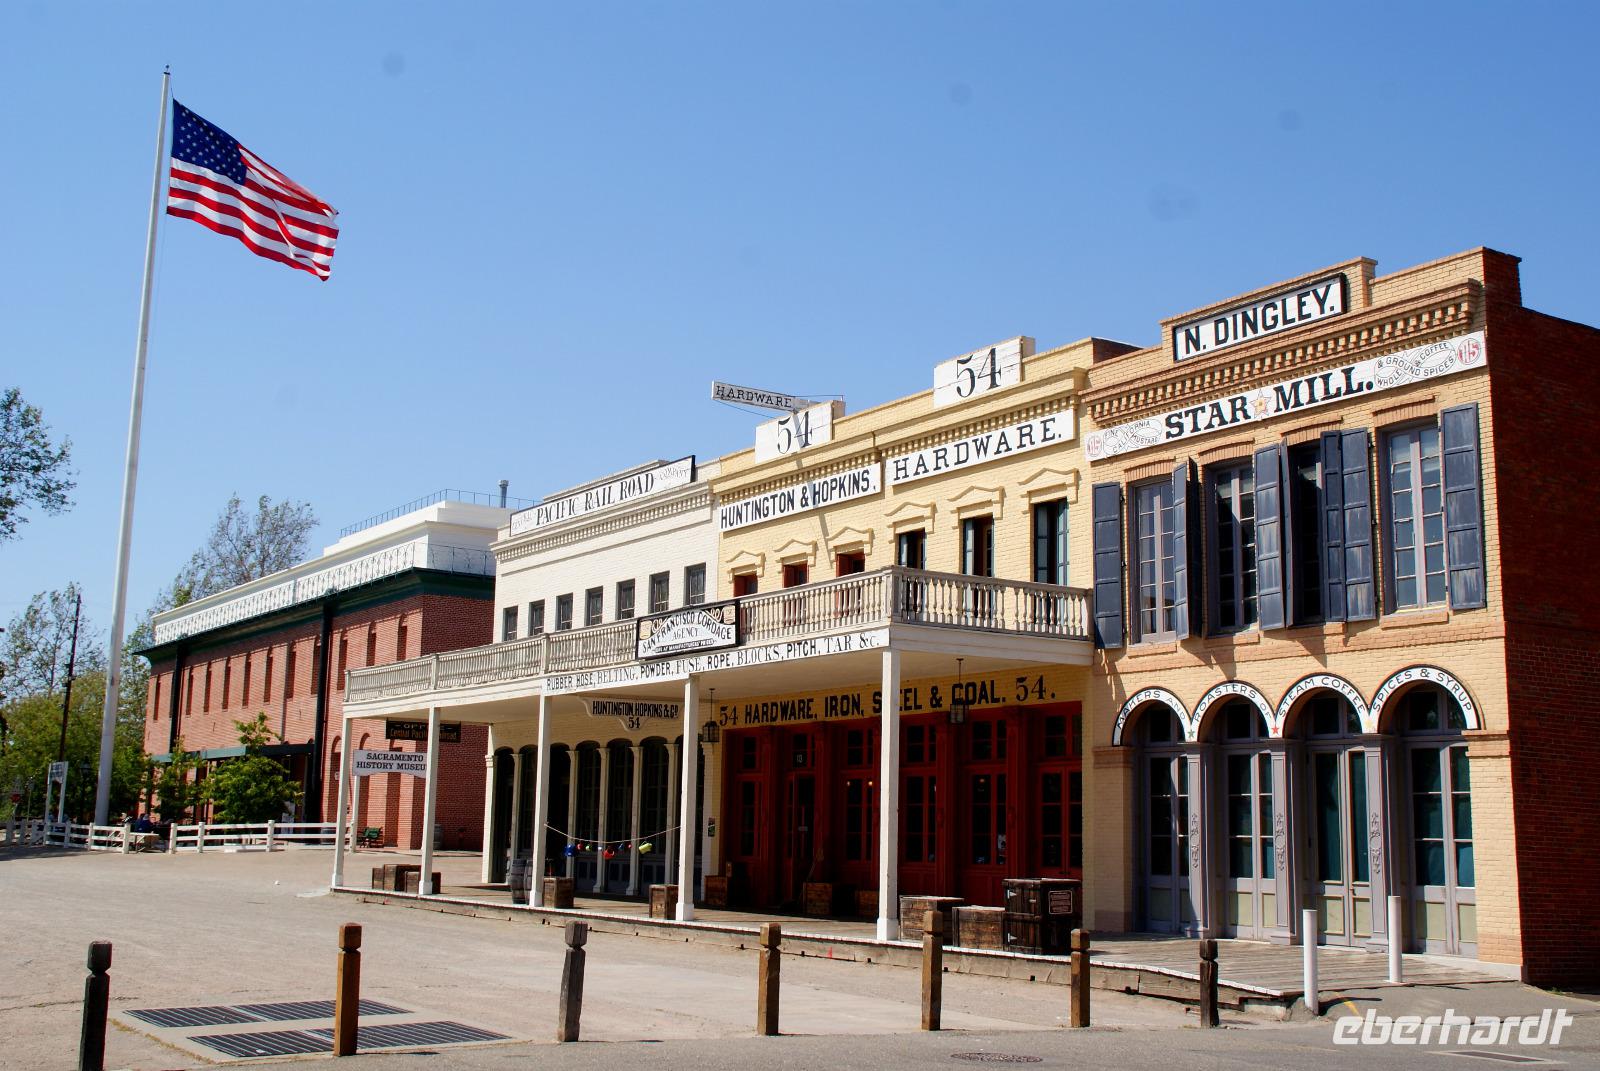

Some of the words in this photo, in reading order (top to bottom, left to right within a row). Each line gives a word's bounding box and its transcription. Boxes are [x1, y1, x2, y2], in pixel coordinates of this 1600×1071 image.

[1185, 325, 1206, 355] N.
[1214, 284, 1335, 346] DINGLEY.
[1386, 356, 1421, 377] GROUND
[1423, 355, 1454, 377] SPICES
[1419, 342, 1449, 361] COFFEE
[956, 347, 1002, 398] 54
[1377, 369, 1402, 387] WHOLE
[715, 385, 792, 408] HARDWARE
[1165, 395, 1251, 440] STAR
[1273, 366, 1374, 413] MILL.
[777, 410, 812, 455] 54
[893, 417, 1062, 481] HARDWARE.
[1105, 429, 1118, 438] FINE
[535, 496, 580, 526] PACIFIC
[584, 485, 616, 512] RAIL
[620, 472, 654, 500] ROAD
[720, 489, 795, 529] HUNTINGTON
[800, 485, 809, 508] &
[812, 469, 876, 506] HOPKINS.
[643, 636, 656, 653] SAN
[656, 611, 695, 642] FRANCISCO
[697, 611, 732, 640] CORDAGE
[673, 627, 698, 640] AGENCY
[546, 676, 573, 691] RUBBER
[640, 662, 674, 679] POWDER,
[786, 640, 820, 659] PITCH,
[824, 634, 852, 654] TAR
[635, 703, 662, 718] HOPKINS
[663, 704, 669, 718] &
[719, 705, 738, 727] 54
[872, 687, 922, 714] SEL
[929, 685, 943, 708] &
[951, 680, 1006, 706] COAL.
[1116, 689, 1161, 730] MAKERS
[1166, 697, 1186, 721] AND
[1194, 682, 1257, 722] ROASTERS
[1259, 702, 1272, 719] OF
[1278, 678, 1315, 718] STEAM
[1321, 676, 1366, 714] COFFEE
[1372, 670, 1413, 713] SPICES
[1419, 668, 1431, 678] &
[1435, 672, 1472, 712] SYRUP
[628, 716, 640, 729] 54
[356, 761, 394, 770] HISTORY
[396, 763, 427, 771] MUSEU
[366, 752, 424, 762] SACRAMENTO
